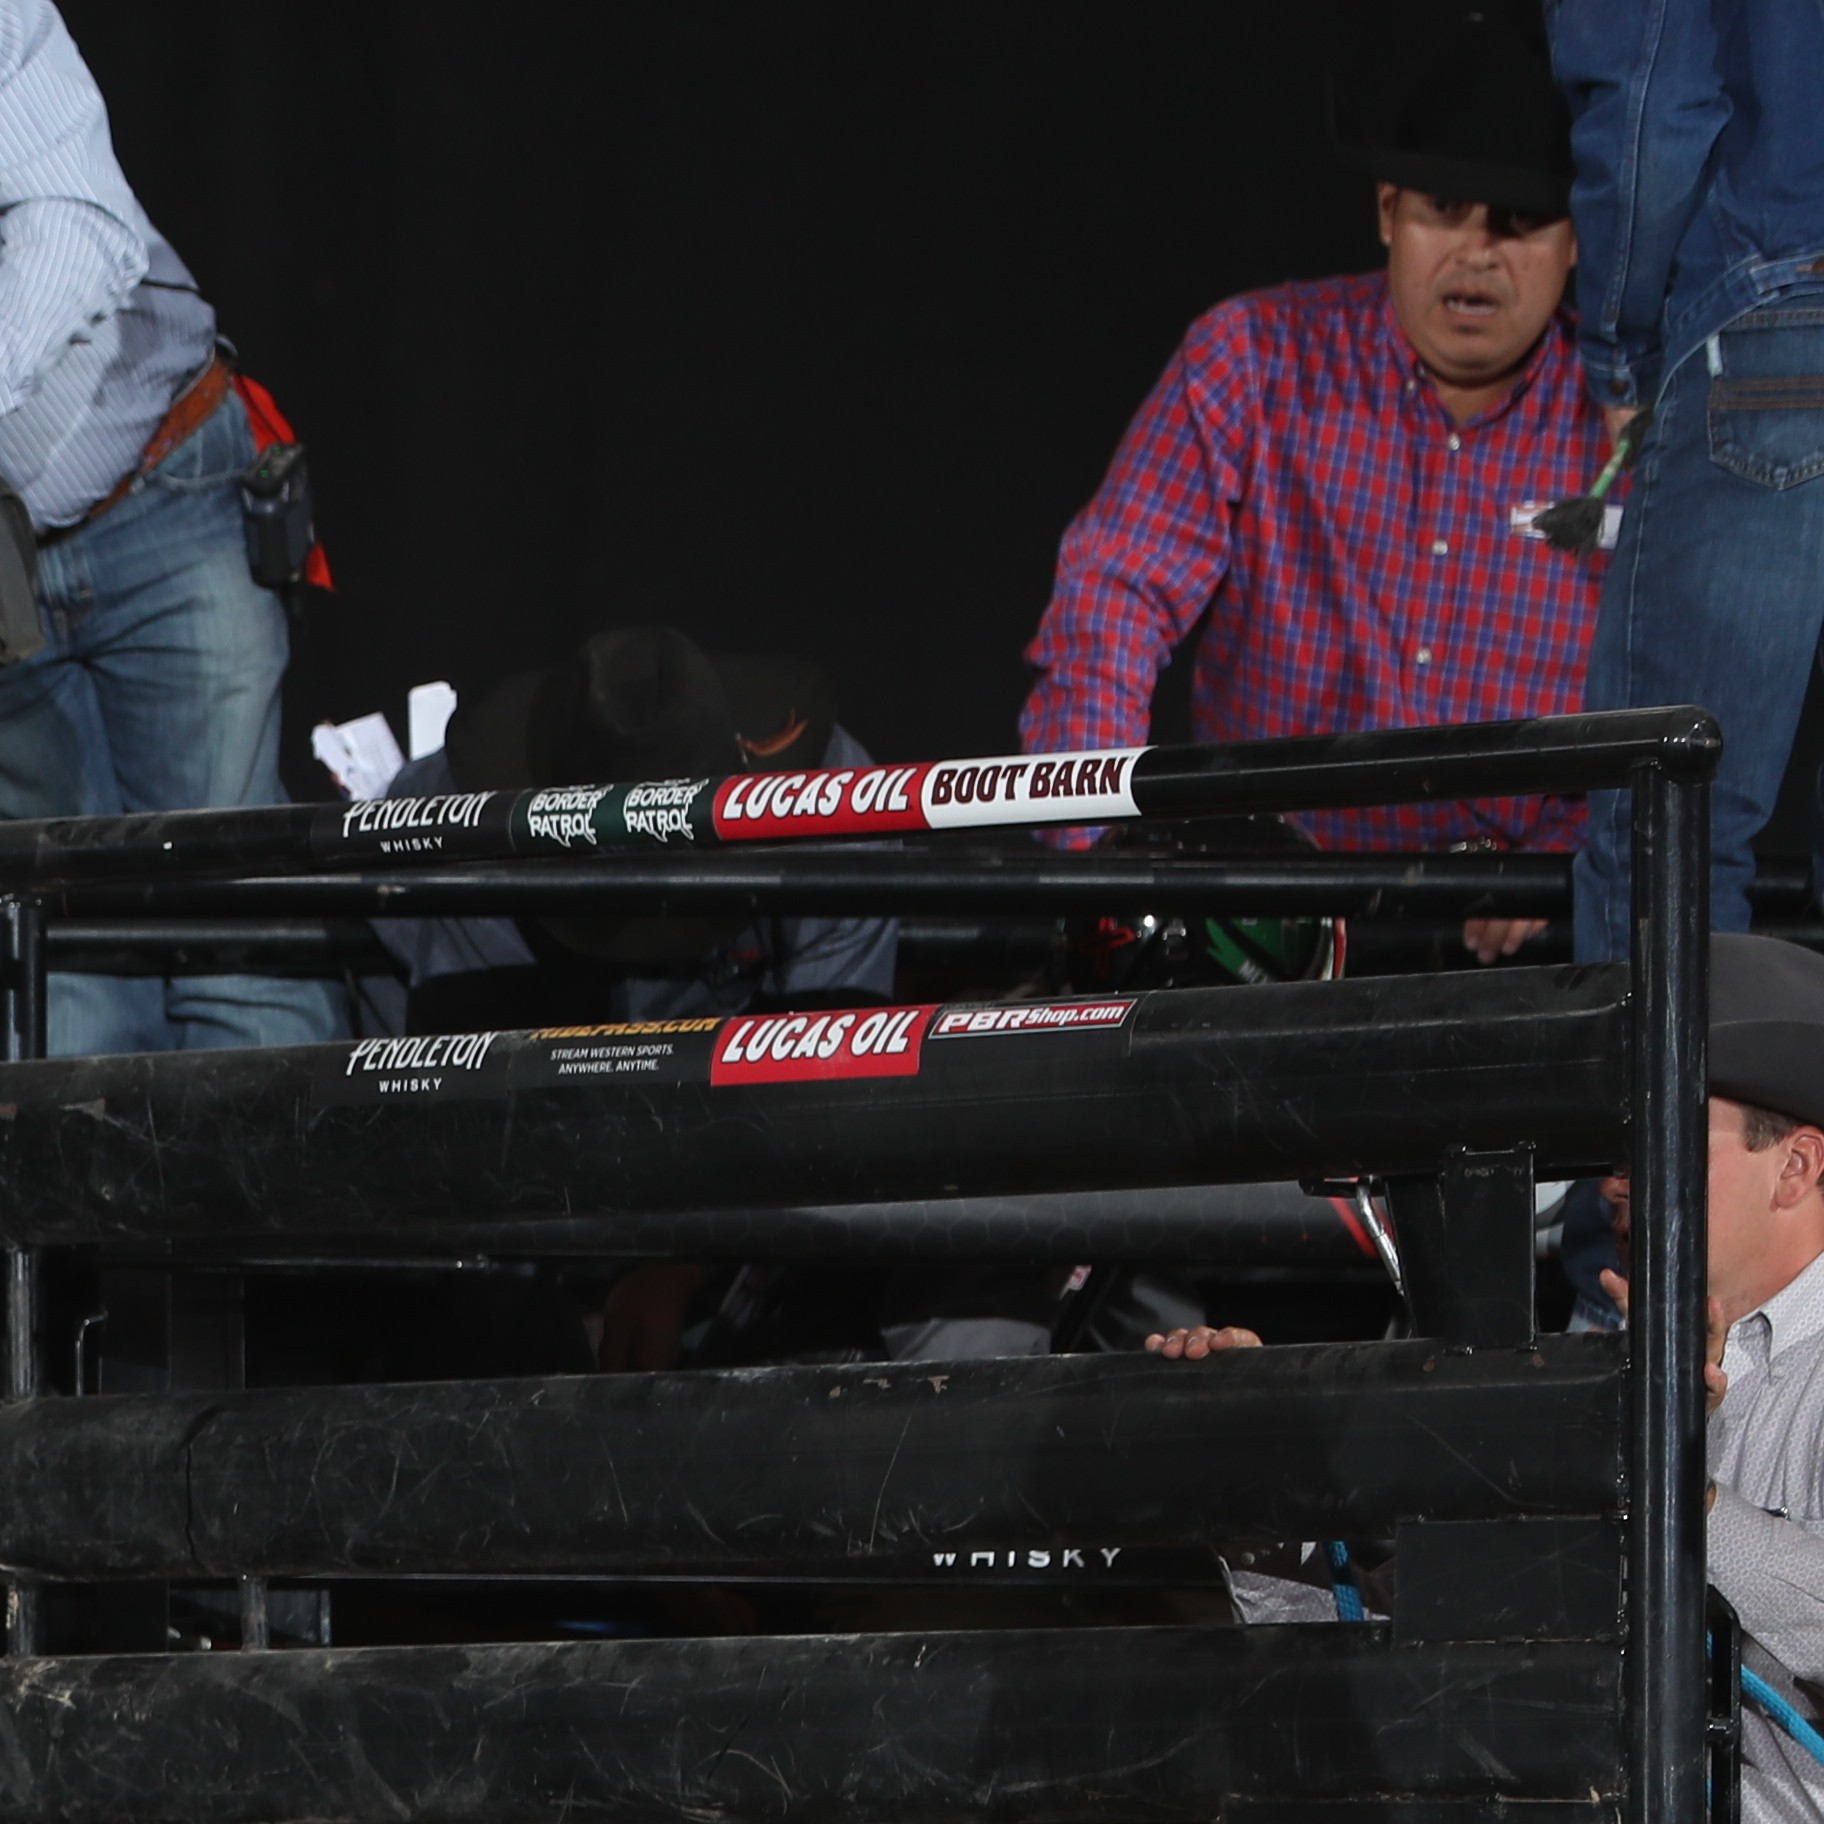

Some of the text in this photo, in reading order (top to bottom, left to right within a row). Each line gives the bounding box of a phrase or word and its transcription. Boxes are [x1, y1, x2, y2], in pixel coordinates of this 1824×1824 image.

[722, 766, 917, 820] LUCAS OIL
[930, 756, 1129, 806] BOOT BARN
[342, 790, 498, 838] PENDLETON
[530, 813, 596, 838] PATROL
[626, 808, 693, 833] PATROL
[380, 835, 444, 854] WHISKY
[938, 1004, 1125, 1033] PBRShop.com
[722, 1010, 920, 1063] LUCAS OIL
[346, 1031, 498, 1076] PENDLETON
[551, 1048, 588, 1060] STREAM
[590, 1046, 634, 1058] WESTERN
[379, 1077, 442, 1094] WHISKY
